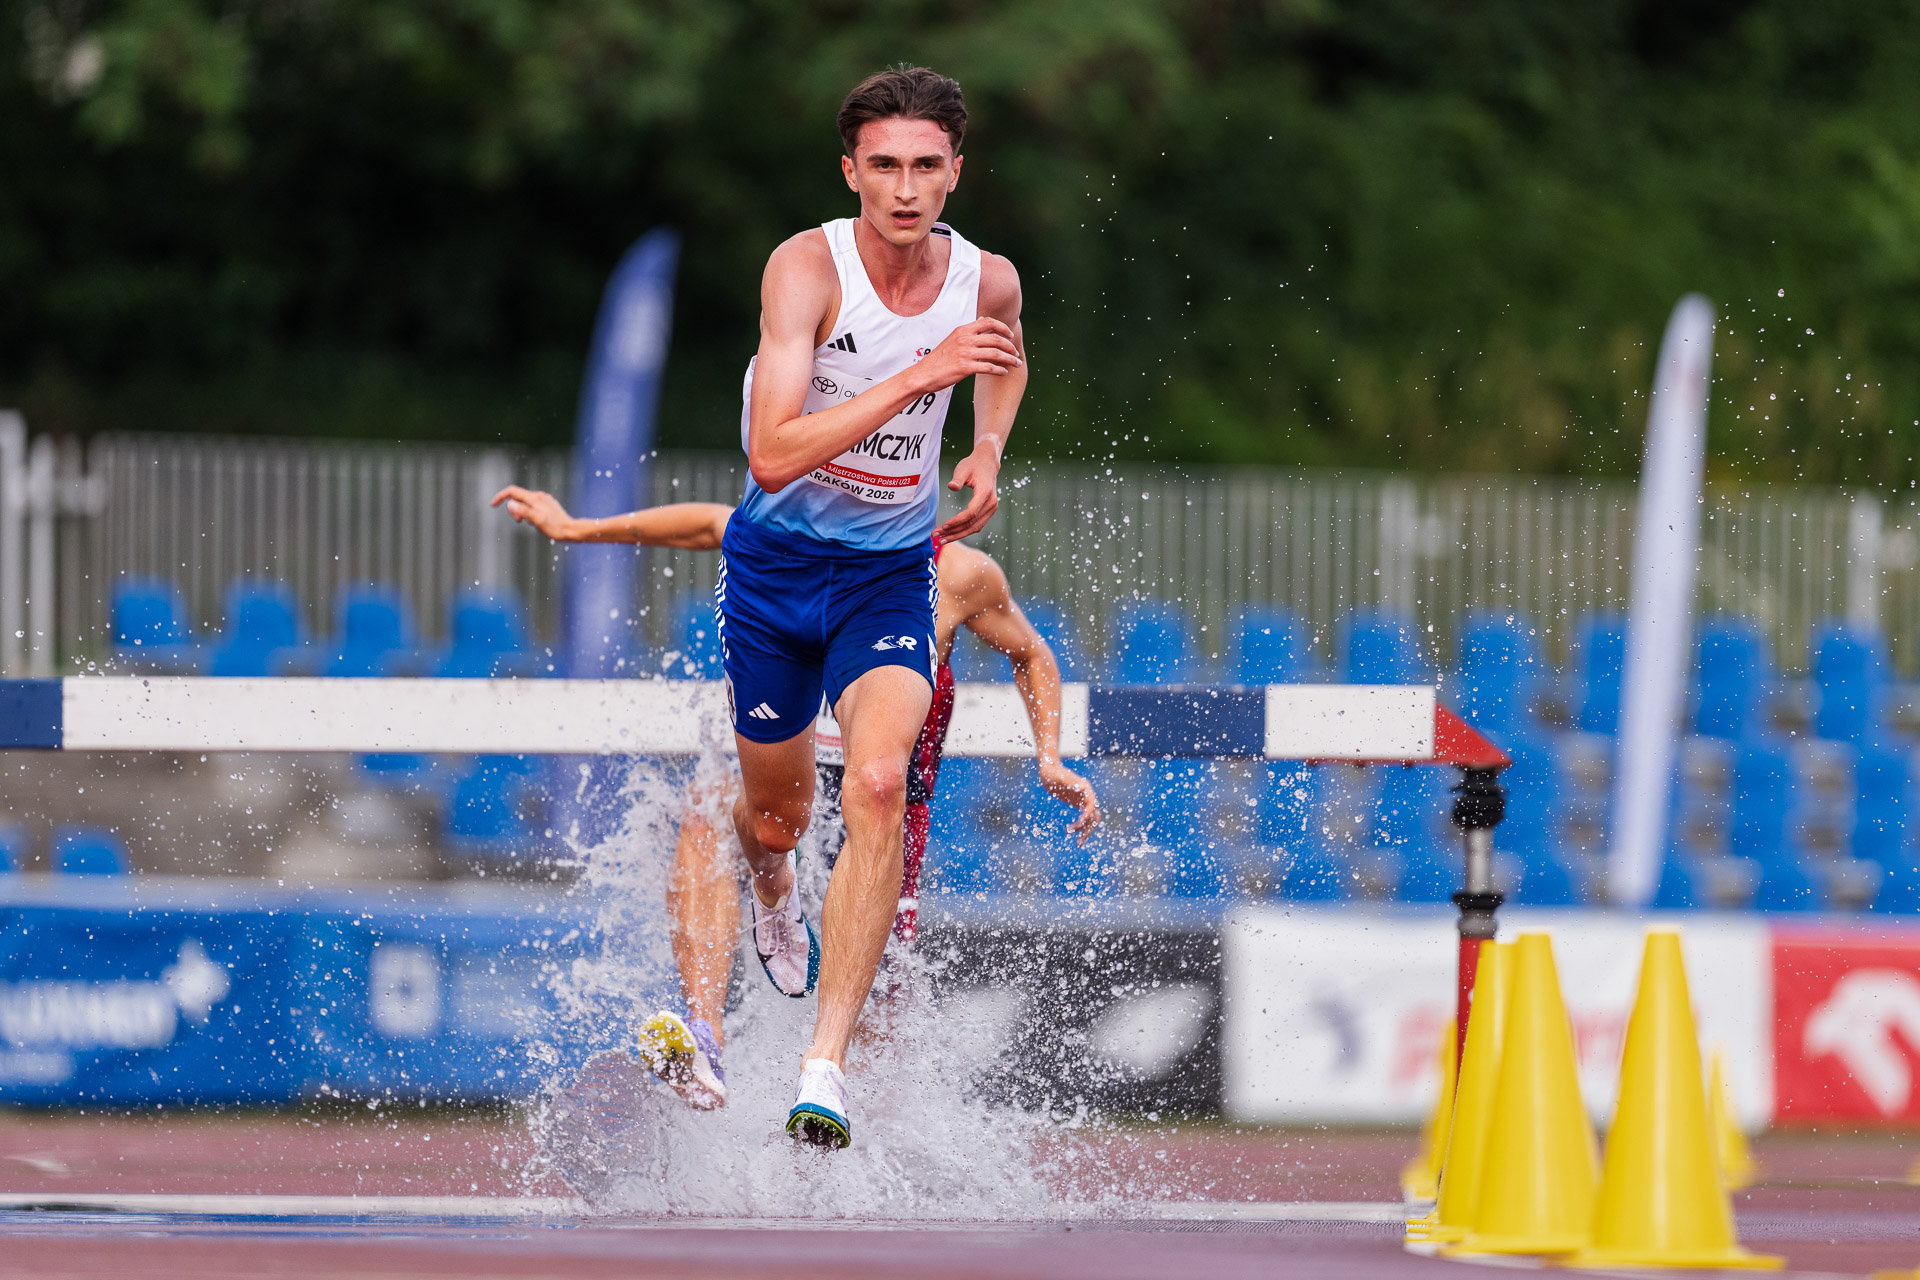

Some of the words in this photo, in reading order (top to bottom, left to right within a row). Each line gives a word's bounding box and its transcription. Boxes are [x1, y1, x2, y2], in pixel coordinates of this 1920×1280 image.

[828, 465, 876, 483] Mistrzostwa
[877, 477, 899, 486] Polski
[866, 488, 895, 500] 2026
